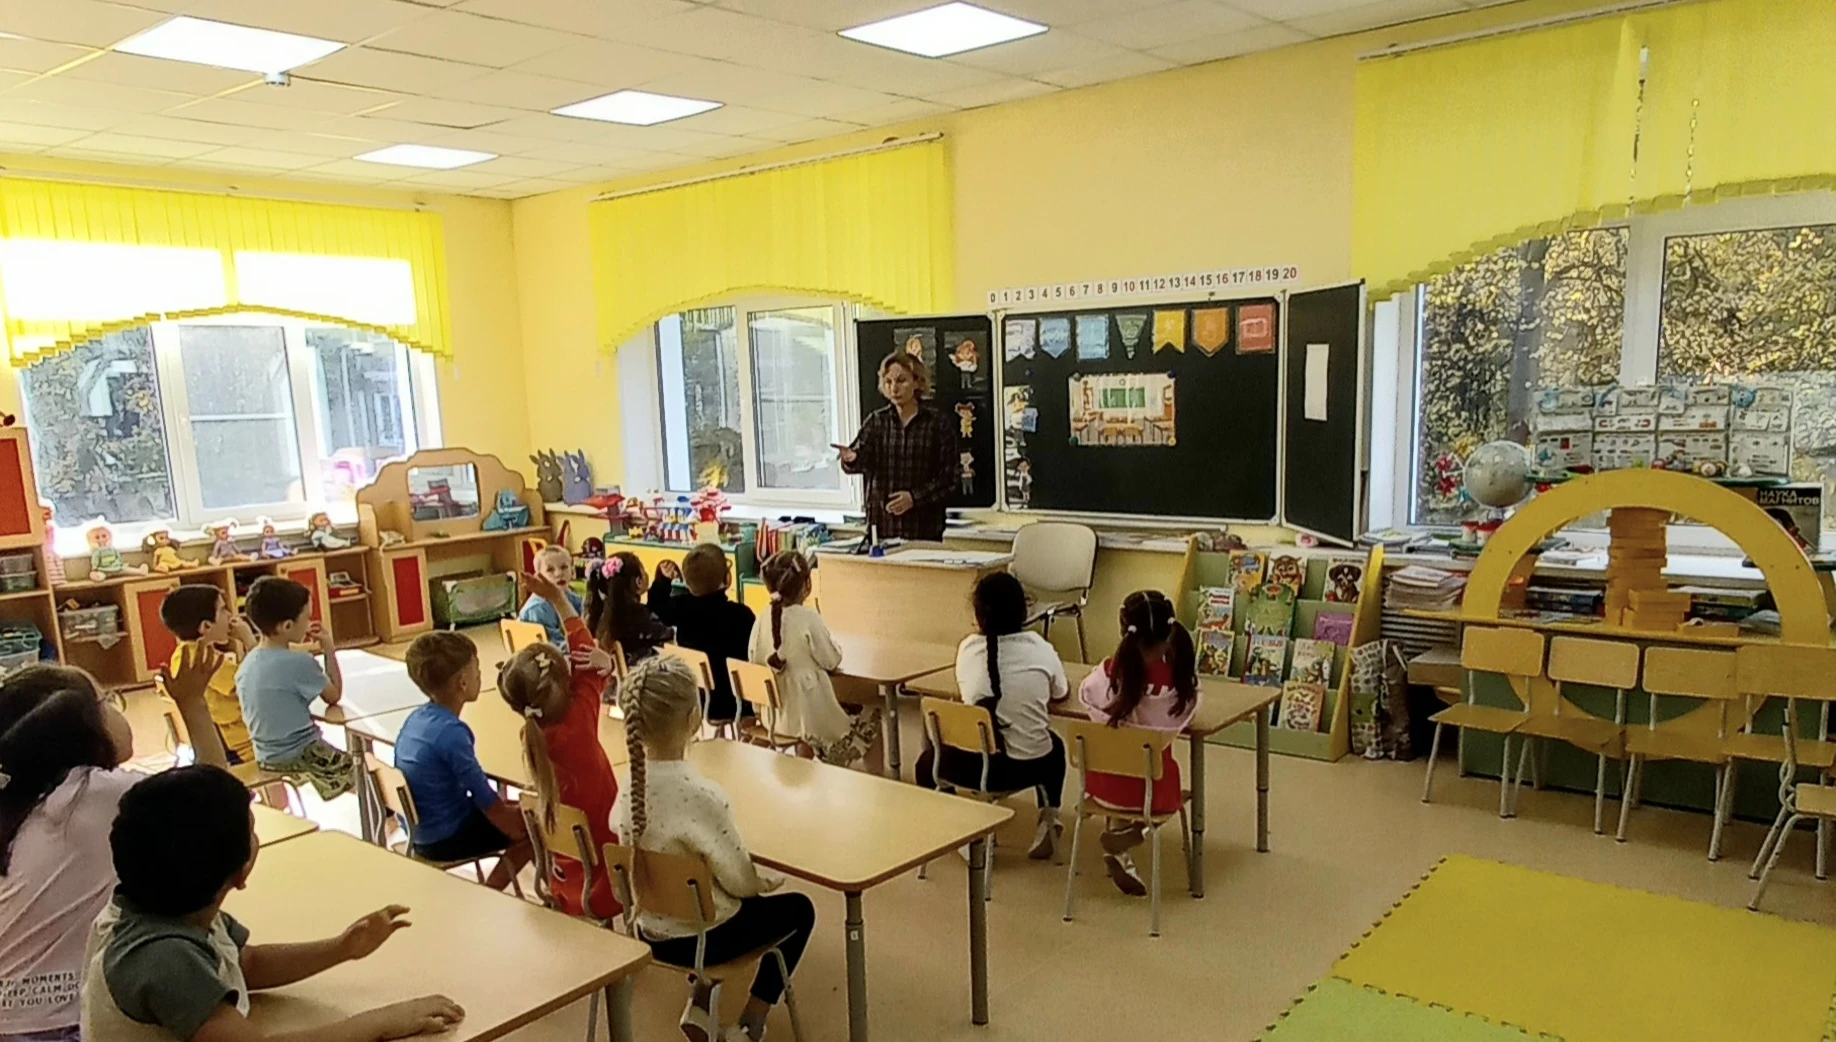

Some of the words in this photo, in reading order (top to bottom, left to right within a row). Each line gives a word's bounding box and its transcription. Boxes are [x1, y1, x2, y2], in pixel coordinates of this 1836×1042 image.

[990, 293, 995, 302] 0
[1004, 292, 1008, 301] 1
[1016, 291, 1021, 300] 2
[1029, 290, 1034, 299] 3
[1042, 288, 1048, 298] 4
[1056, 287, 1061, 297] 5
[1070, 286, 1075, 296] 6
[1083, 285, 1088, 294] 7
[1097, 284, 1102, 294] 8
[1112, 282, 1117, 292] 9
[1124, 281, 1135, 291] 10
[1140, 280, 1149, 290] 11
[1154, 278, 1165, 289] 12
[1169, 277, 1180, 288] 13
[1184, 276, 1196, 287] 14
[1200, 274, 1212, 285] 15
[1216, 273, 1228, 284] 16
[1232, 272, 1245, 283] 17
[1249, 270, 1262, 281] 18
[1266, 269, 1278, 280] 19
[1282, 267, 1297, 279] 20
[1760, 489, 1797, 497] НАУКА
[1759, 496, 1820, 505] МАГНИТОВ
[22, 973, 74, 985] MOMENTS
[20, 998, 43, 1007] YOU
